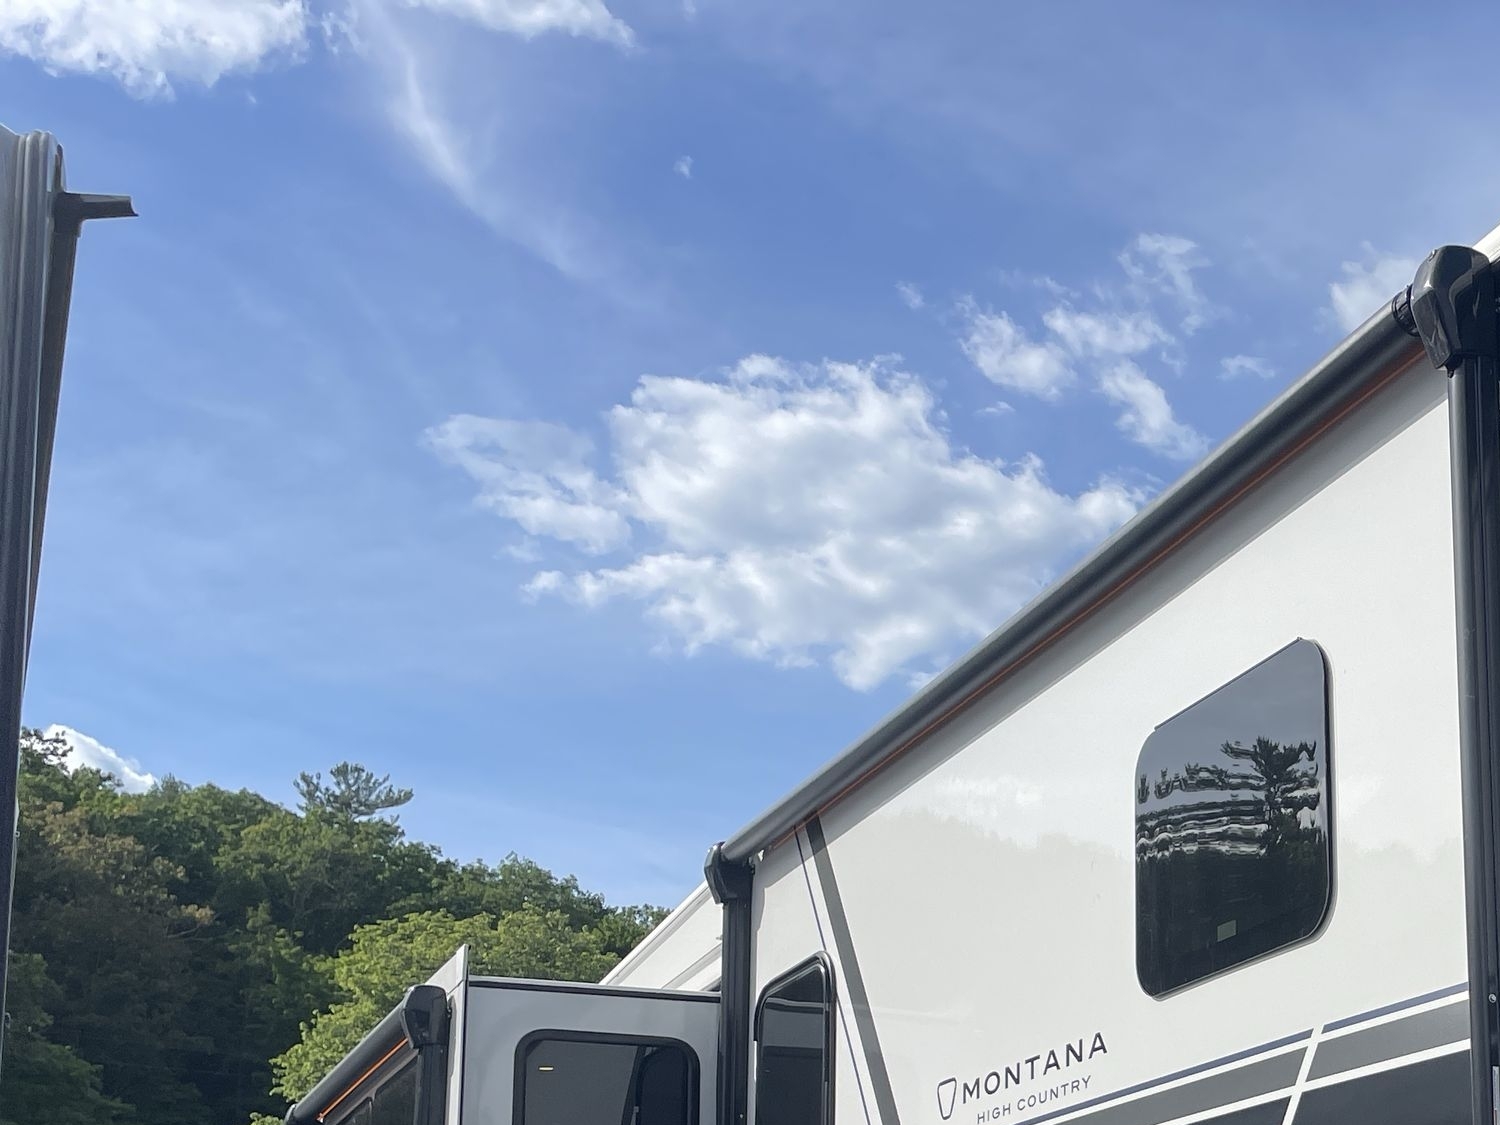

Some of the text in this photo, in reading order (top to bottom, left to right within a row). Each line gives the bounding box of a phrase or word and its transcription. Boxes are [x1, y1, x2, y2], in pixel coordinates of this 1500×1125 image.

[961, 1031, 1108, 1105] MONTANA
[976, 1074, 1092, 1125] HIGH COUNTRY
